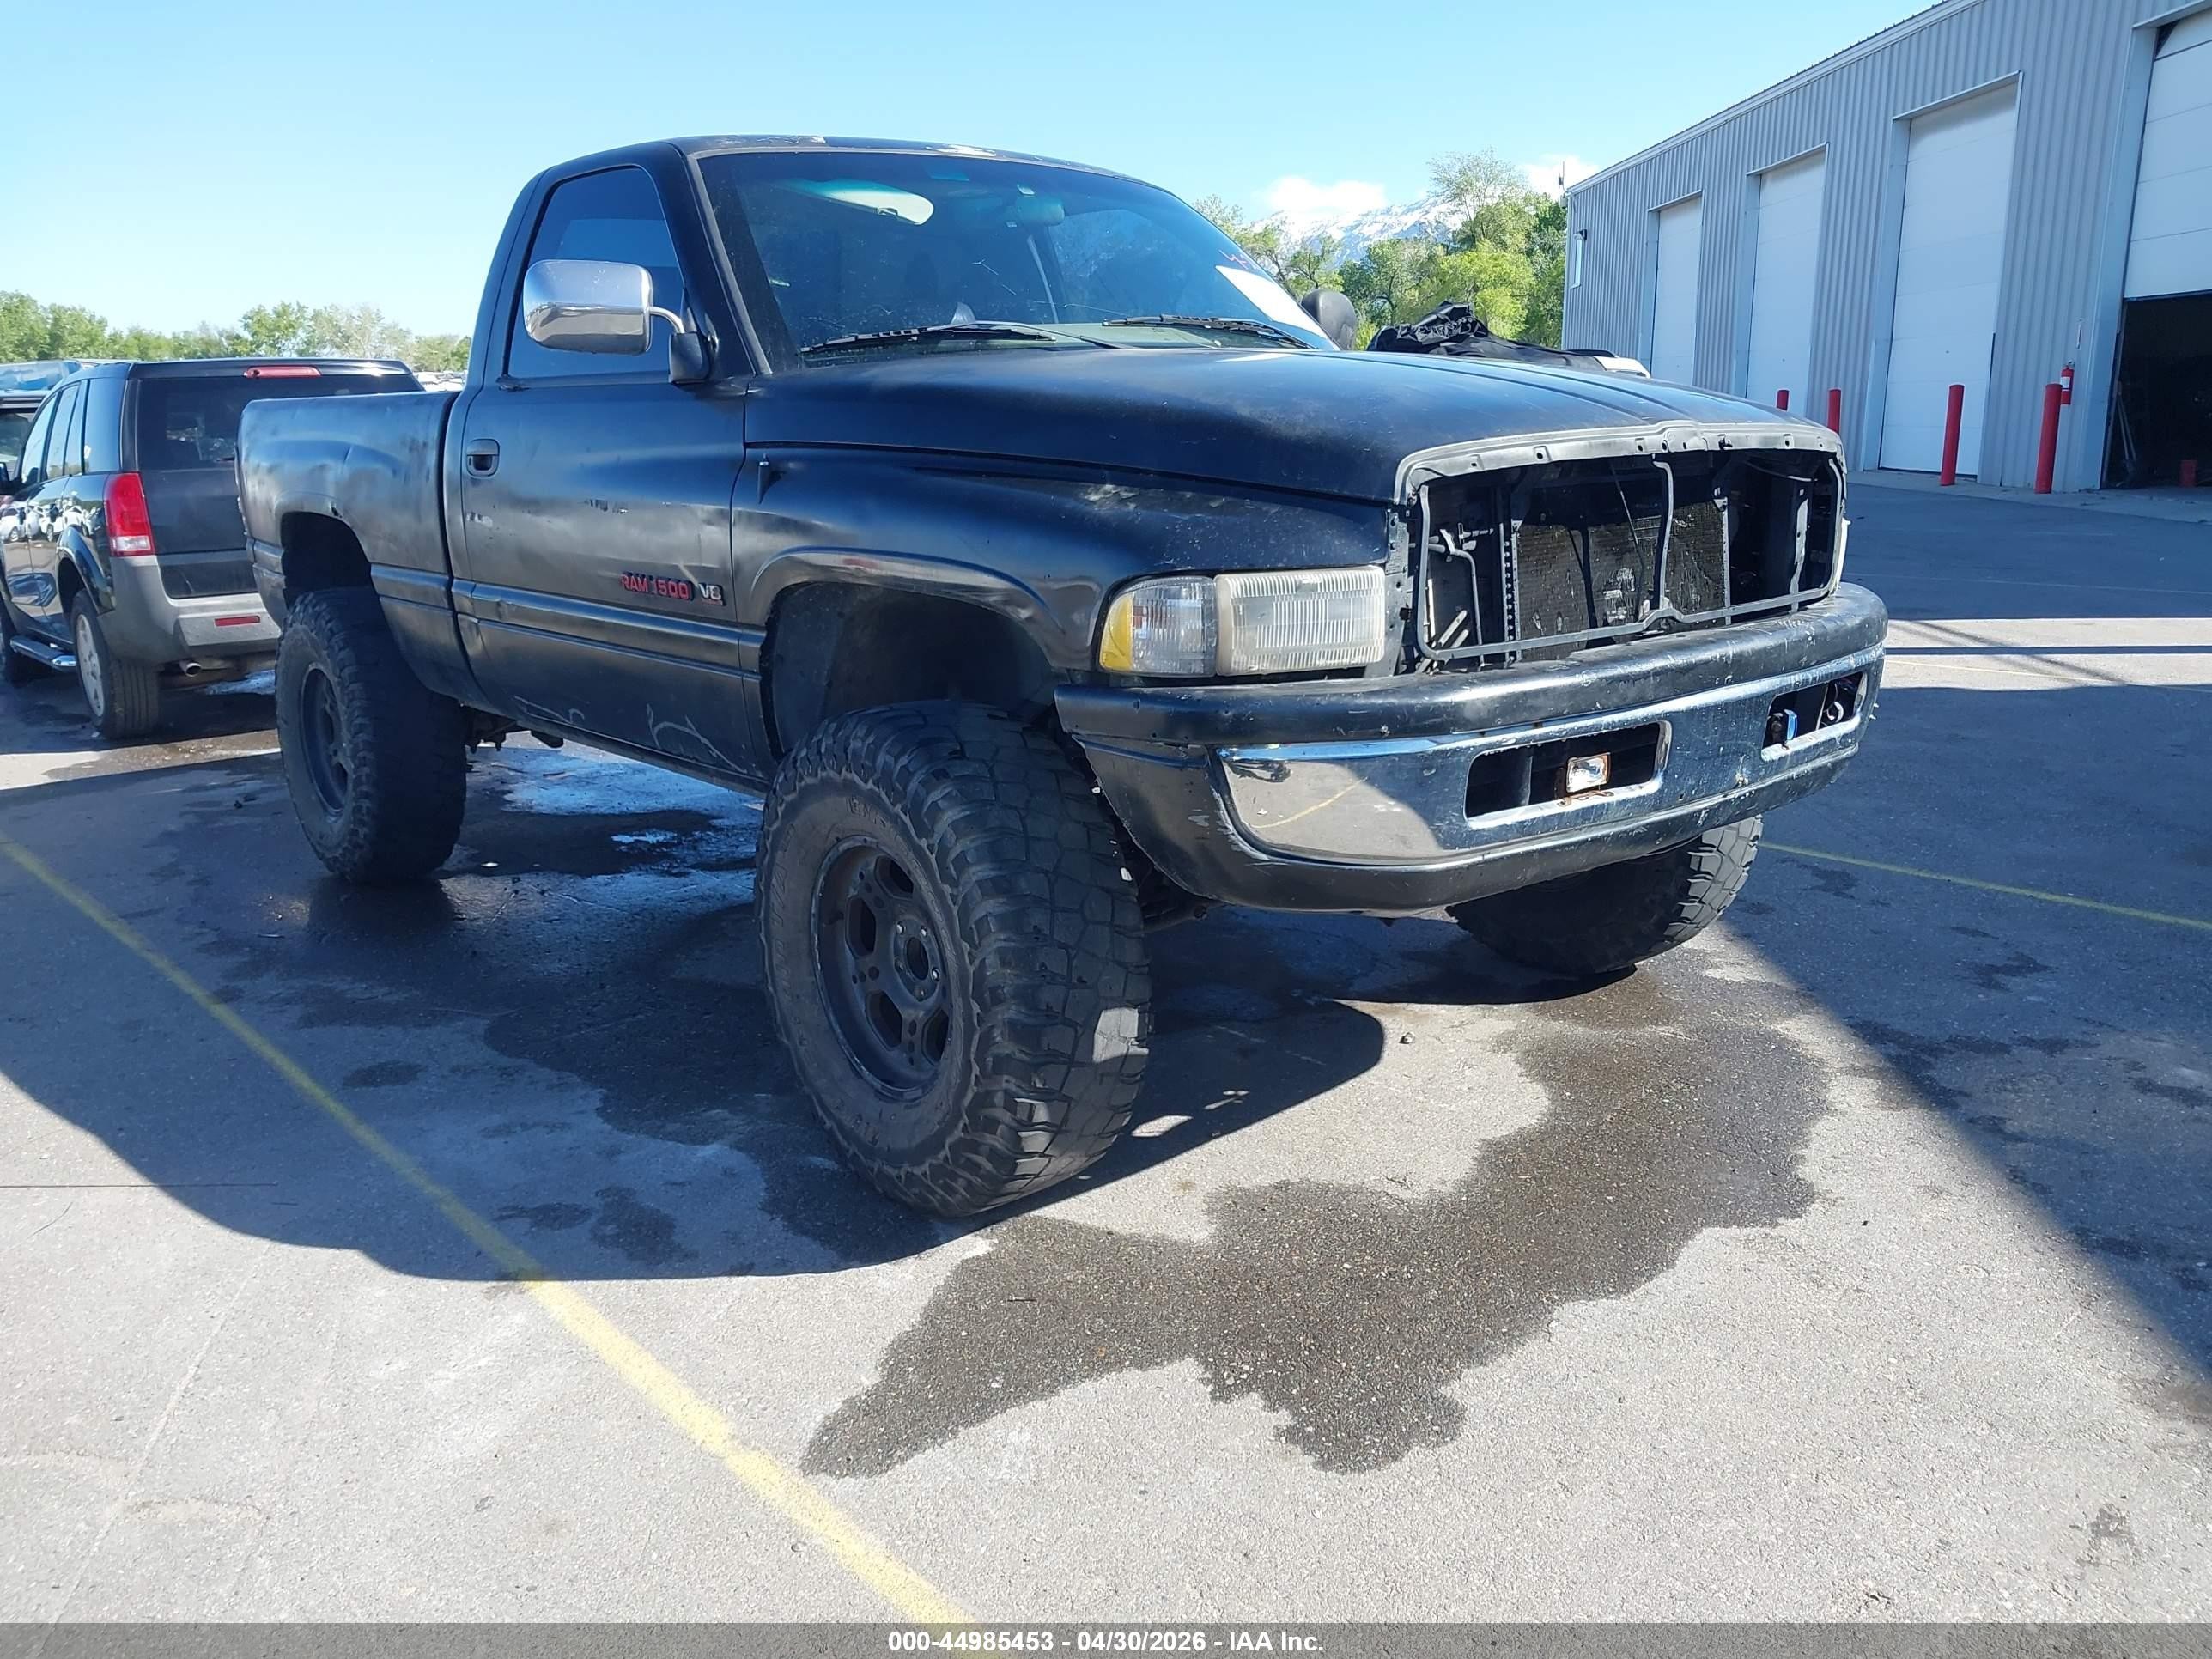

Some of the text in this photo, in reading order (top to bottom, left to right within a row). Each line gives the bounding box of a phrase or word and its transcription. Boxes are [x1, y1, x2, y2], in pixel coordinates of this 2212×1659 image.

[620, 574, 722, 601] RAM 1500 V8
